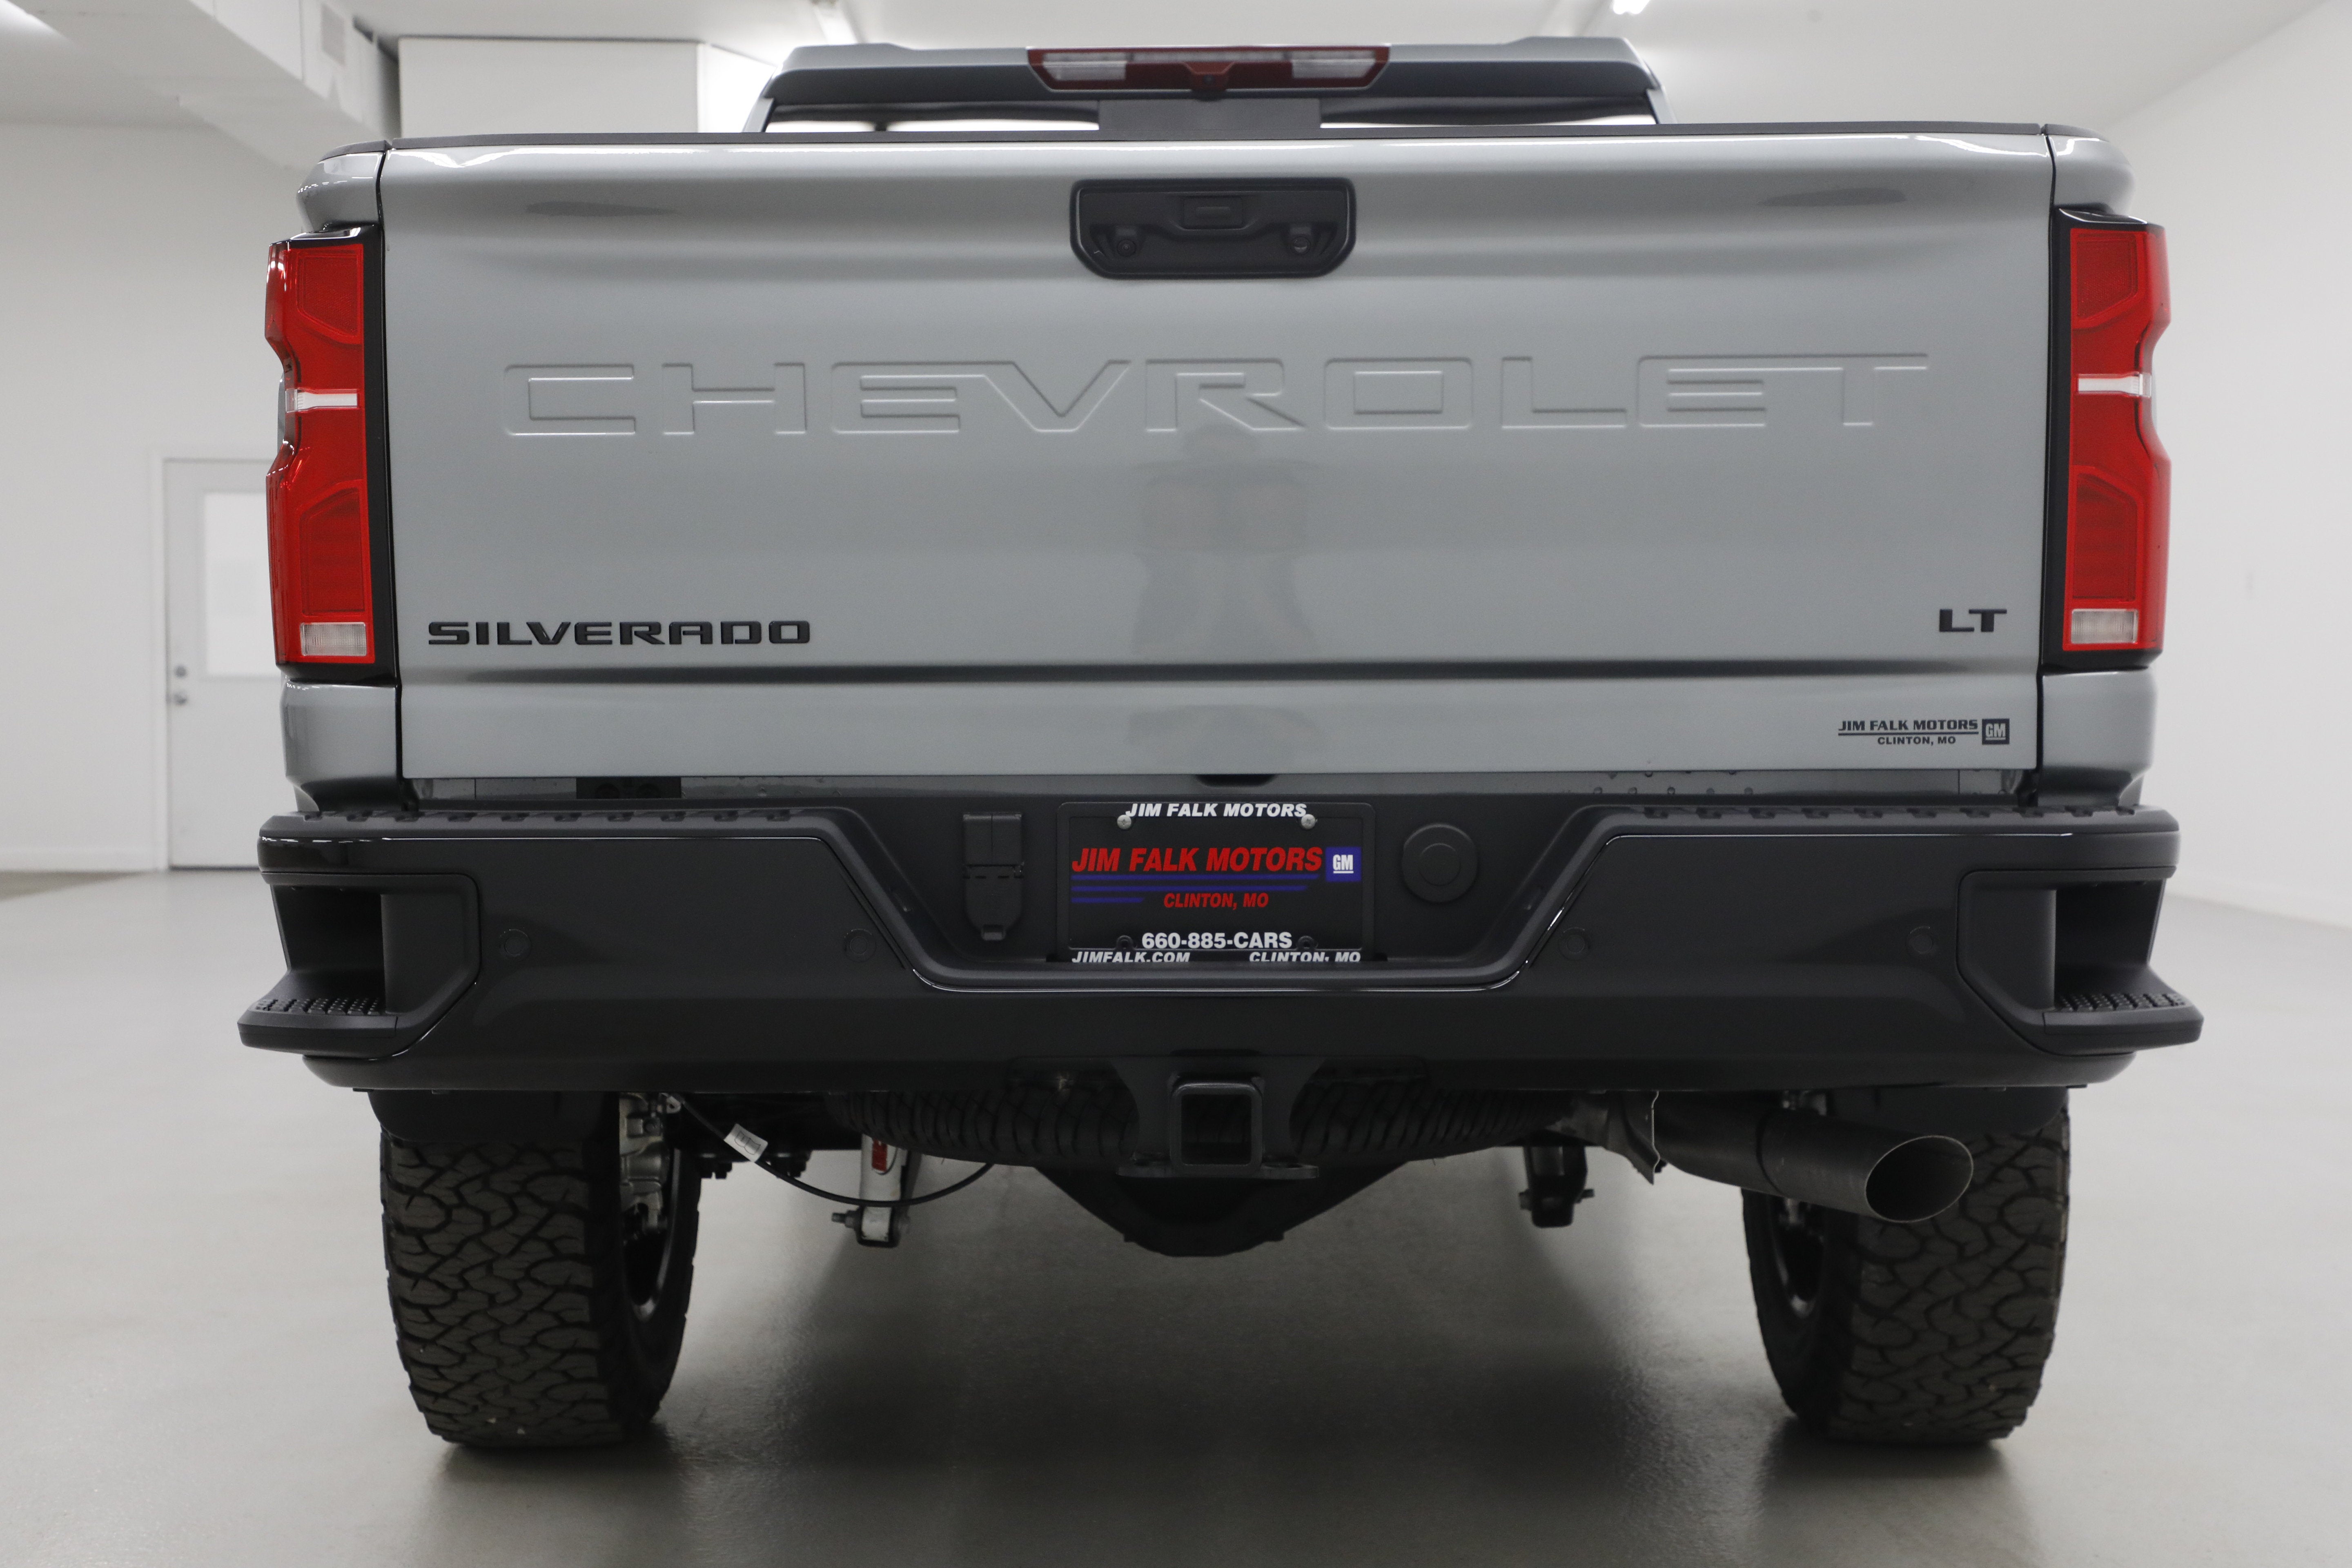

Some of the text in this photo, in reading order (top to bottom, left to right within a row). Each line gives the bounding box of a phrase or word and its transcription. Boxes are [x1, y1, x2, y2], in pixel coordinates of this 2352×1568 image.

[503, 352, 1929, 436] CHEVROLET
[1939, 608, 2007, 633] LT
[428, 620, 811, 646] SILVERADO
[1838, 719, 1979, 731] JIM FALK MOTORS
[1985, 723, 2006, 737] GM
[1877, 736, 1956, 746] CLINTON, MO
[1125, 803, 1307, 817] JIM FALK MOTORS
[1071, 846, 1323, 872] JIM FALK MOTORS
[1332, 854, 1354, 871] GM
[1163, 892, 1269, 910] CLINTON, MO
[1142, 932, 1292, 949] 660-885-CARS
[1071, 951, 1190, 963] JIMFALK.COM
[1249, 951, 1361, 962] CLINTON, MO
